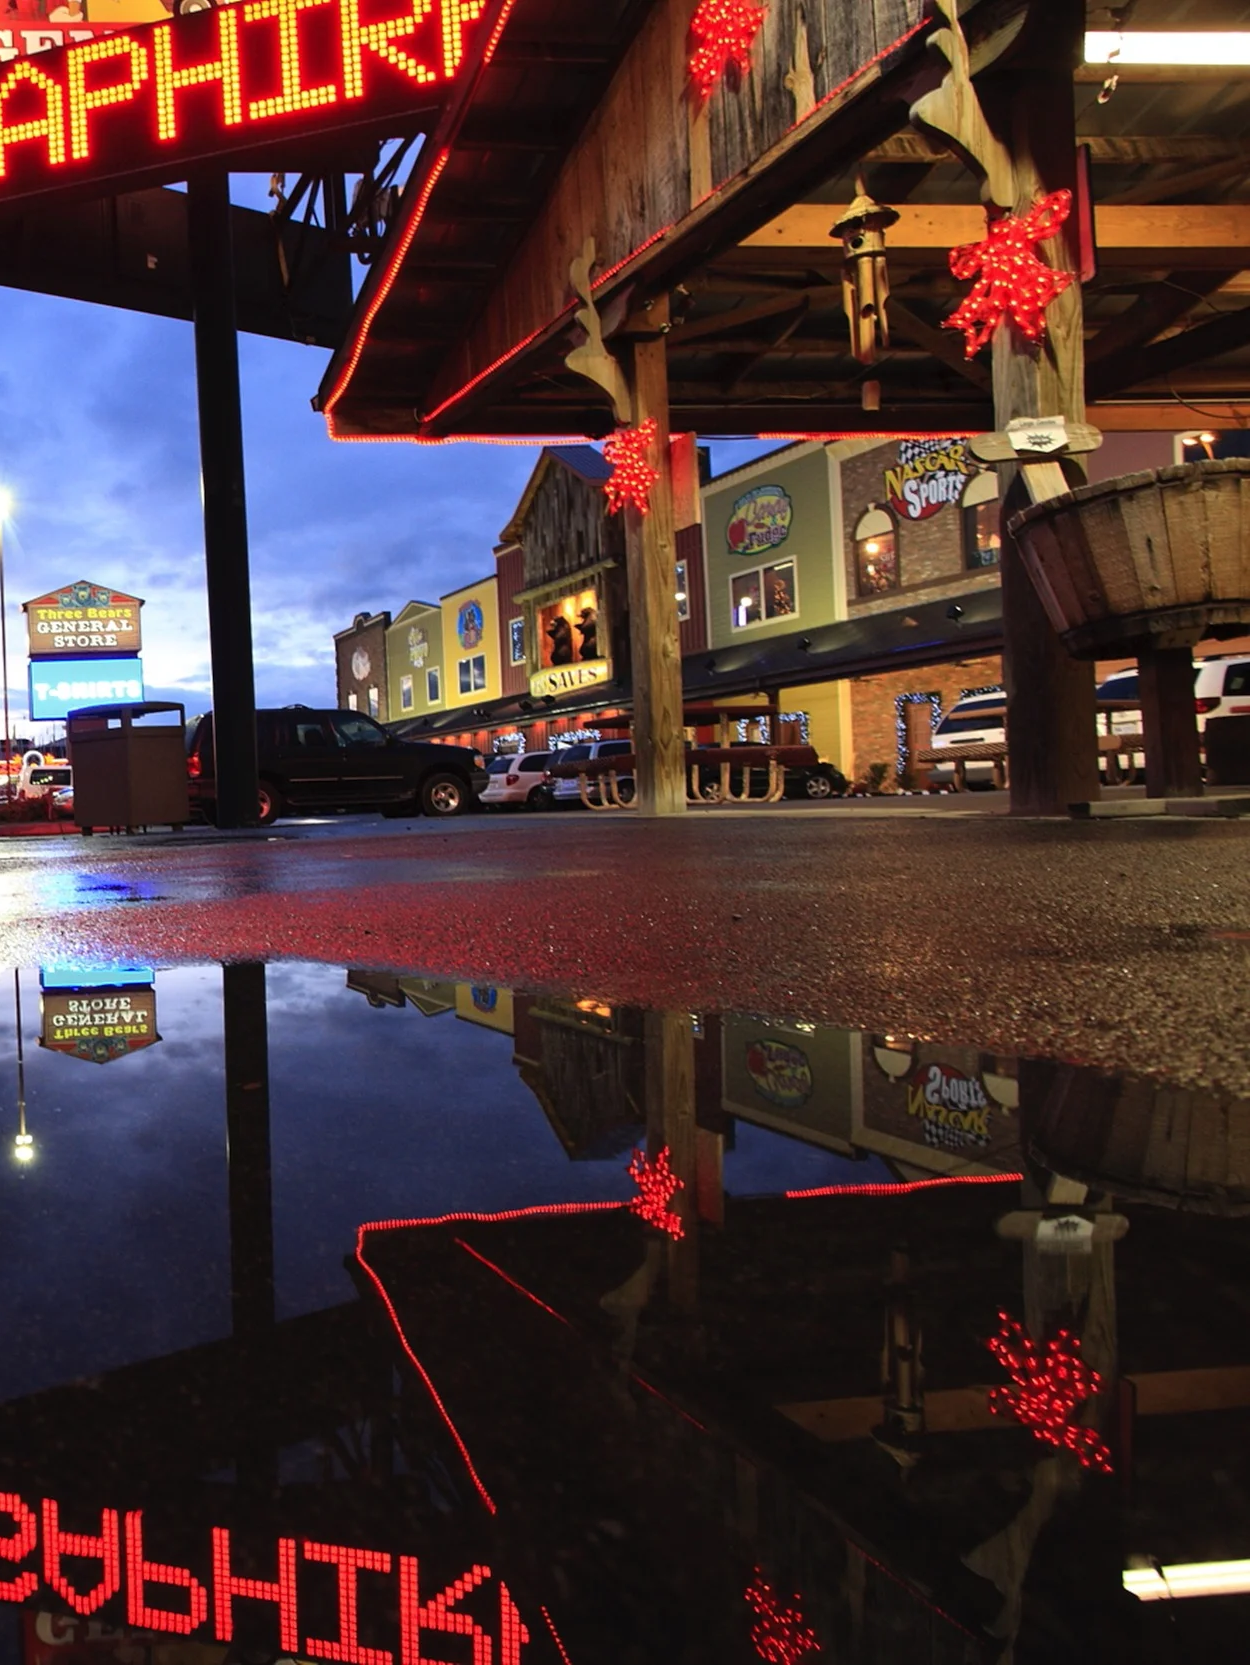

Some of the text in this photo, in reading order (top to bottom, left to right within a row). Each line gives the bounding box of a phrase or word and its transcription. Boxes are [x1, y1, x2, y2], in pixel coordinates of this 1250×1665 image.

[885, 445, 971, 501] NASCAR
[903, 474, 966, 518] SPORTS
[37, 607, 132, 619] Three Bears
[37, 620, 133, 633] GENERAL
[54, 634, 118, 647] STORE
